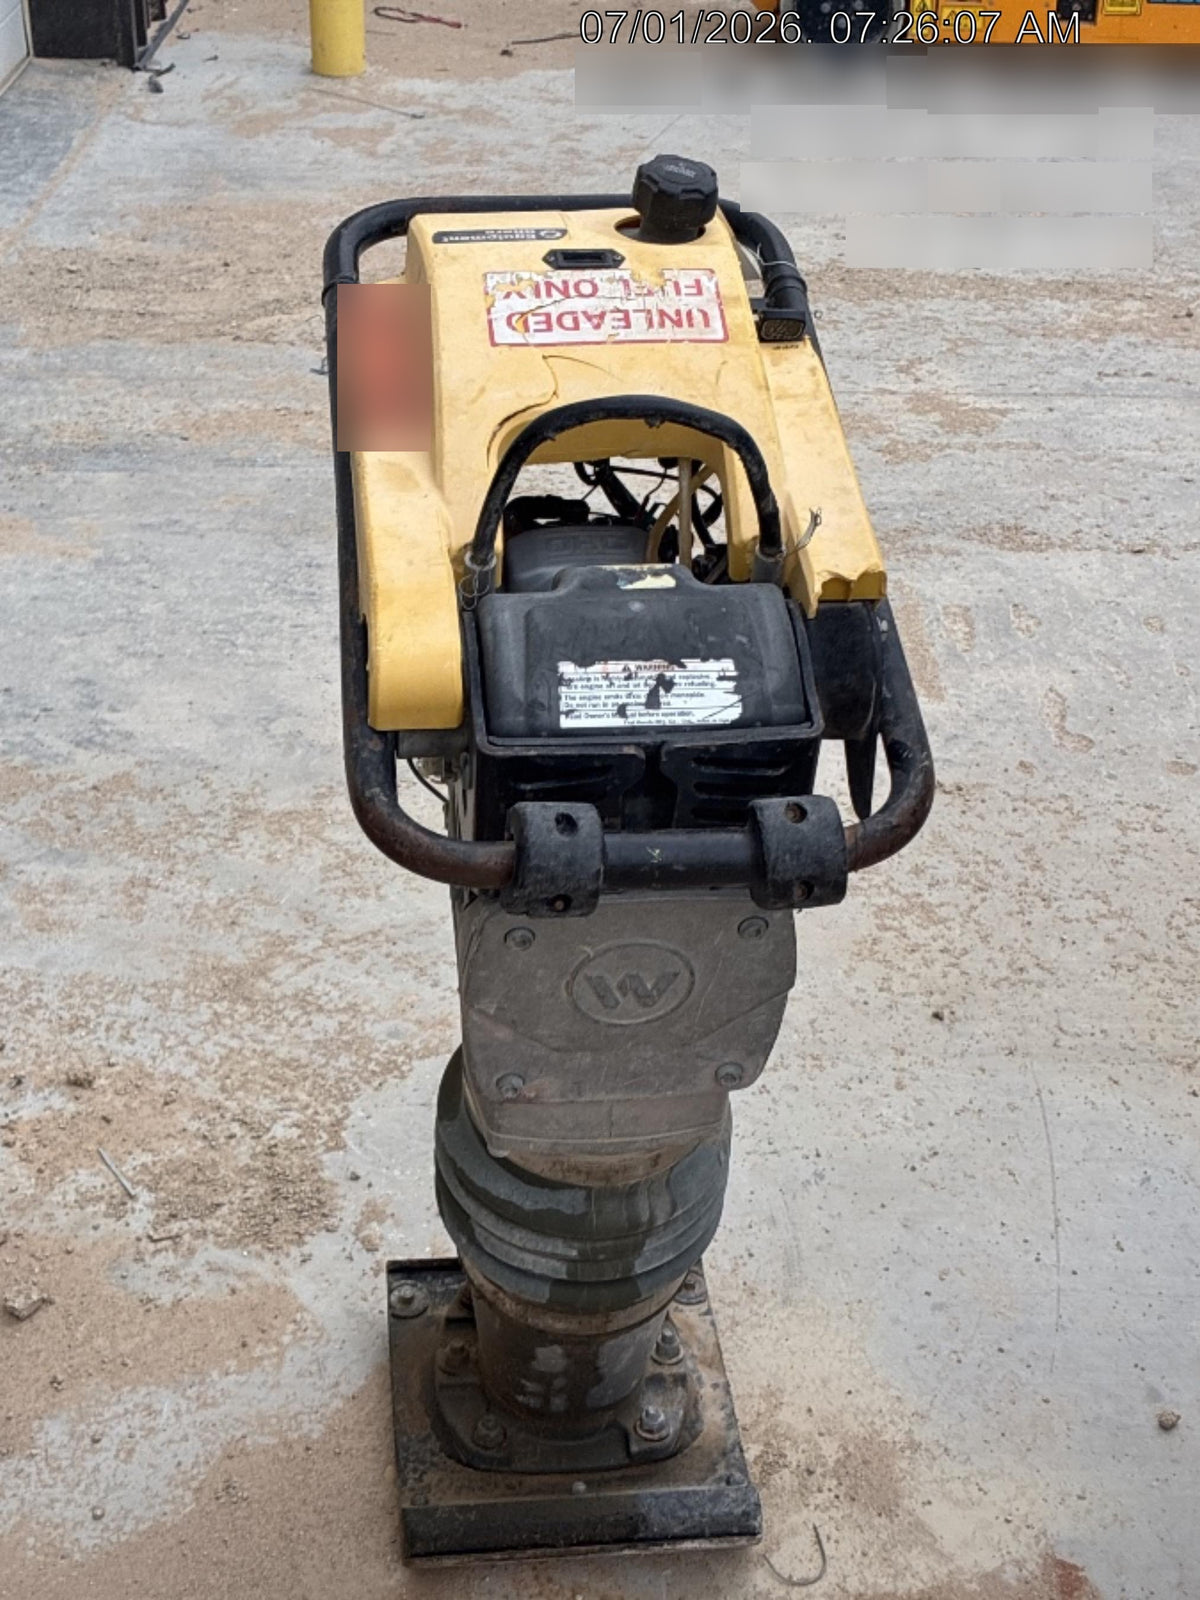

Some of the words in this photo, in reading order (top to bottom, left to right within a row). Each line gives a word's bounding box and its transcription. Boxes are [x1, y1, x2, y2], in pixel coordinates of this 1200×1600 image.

[502, 279, 599, 300] ONLY
[505, 307, 711, 334] UNLEADED
[581, 970, 681, 1009] W
